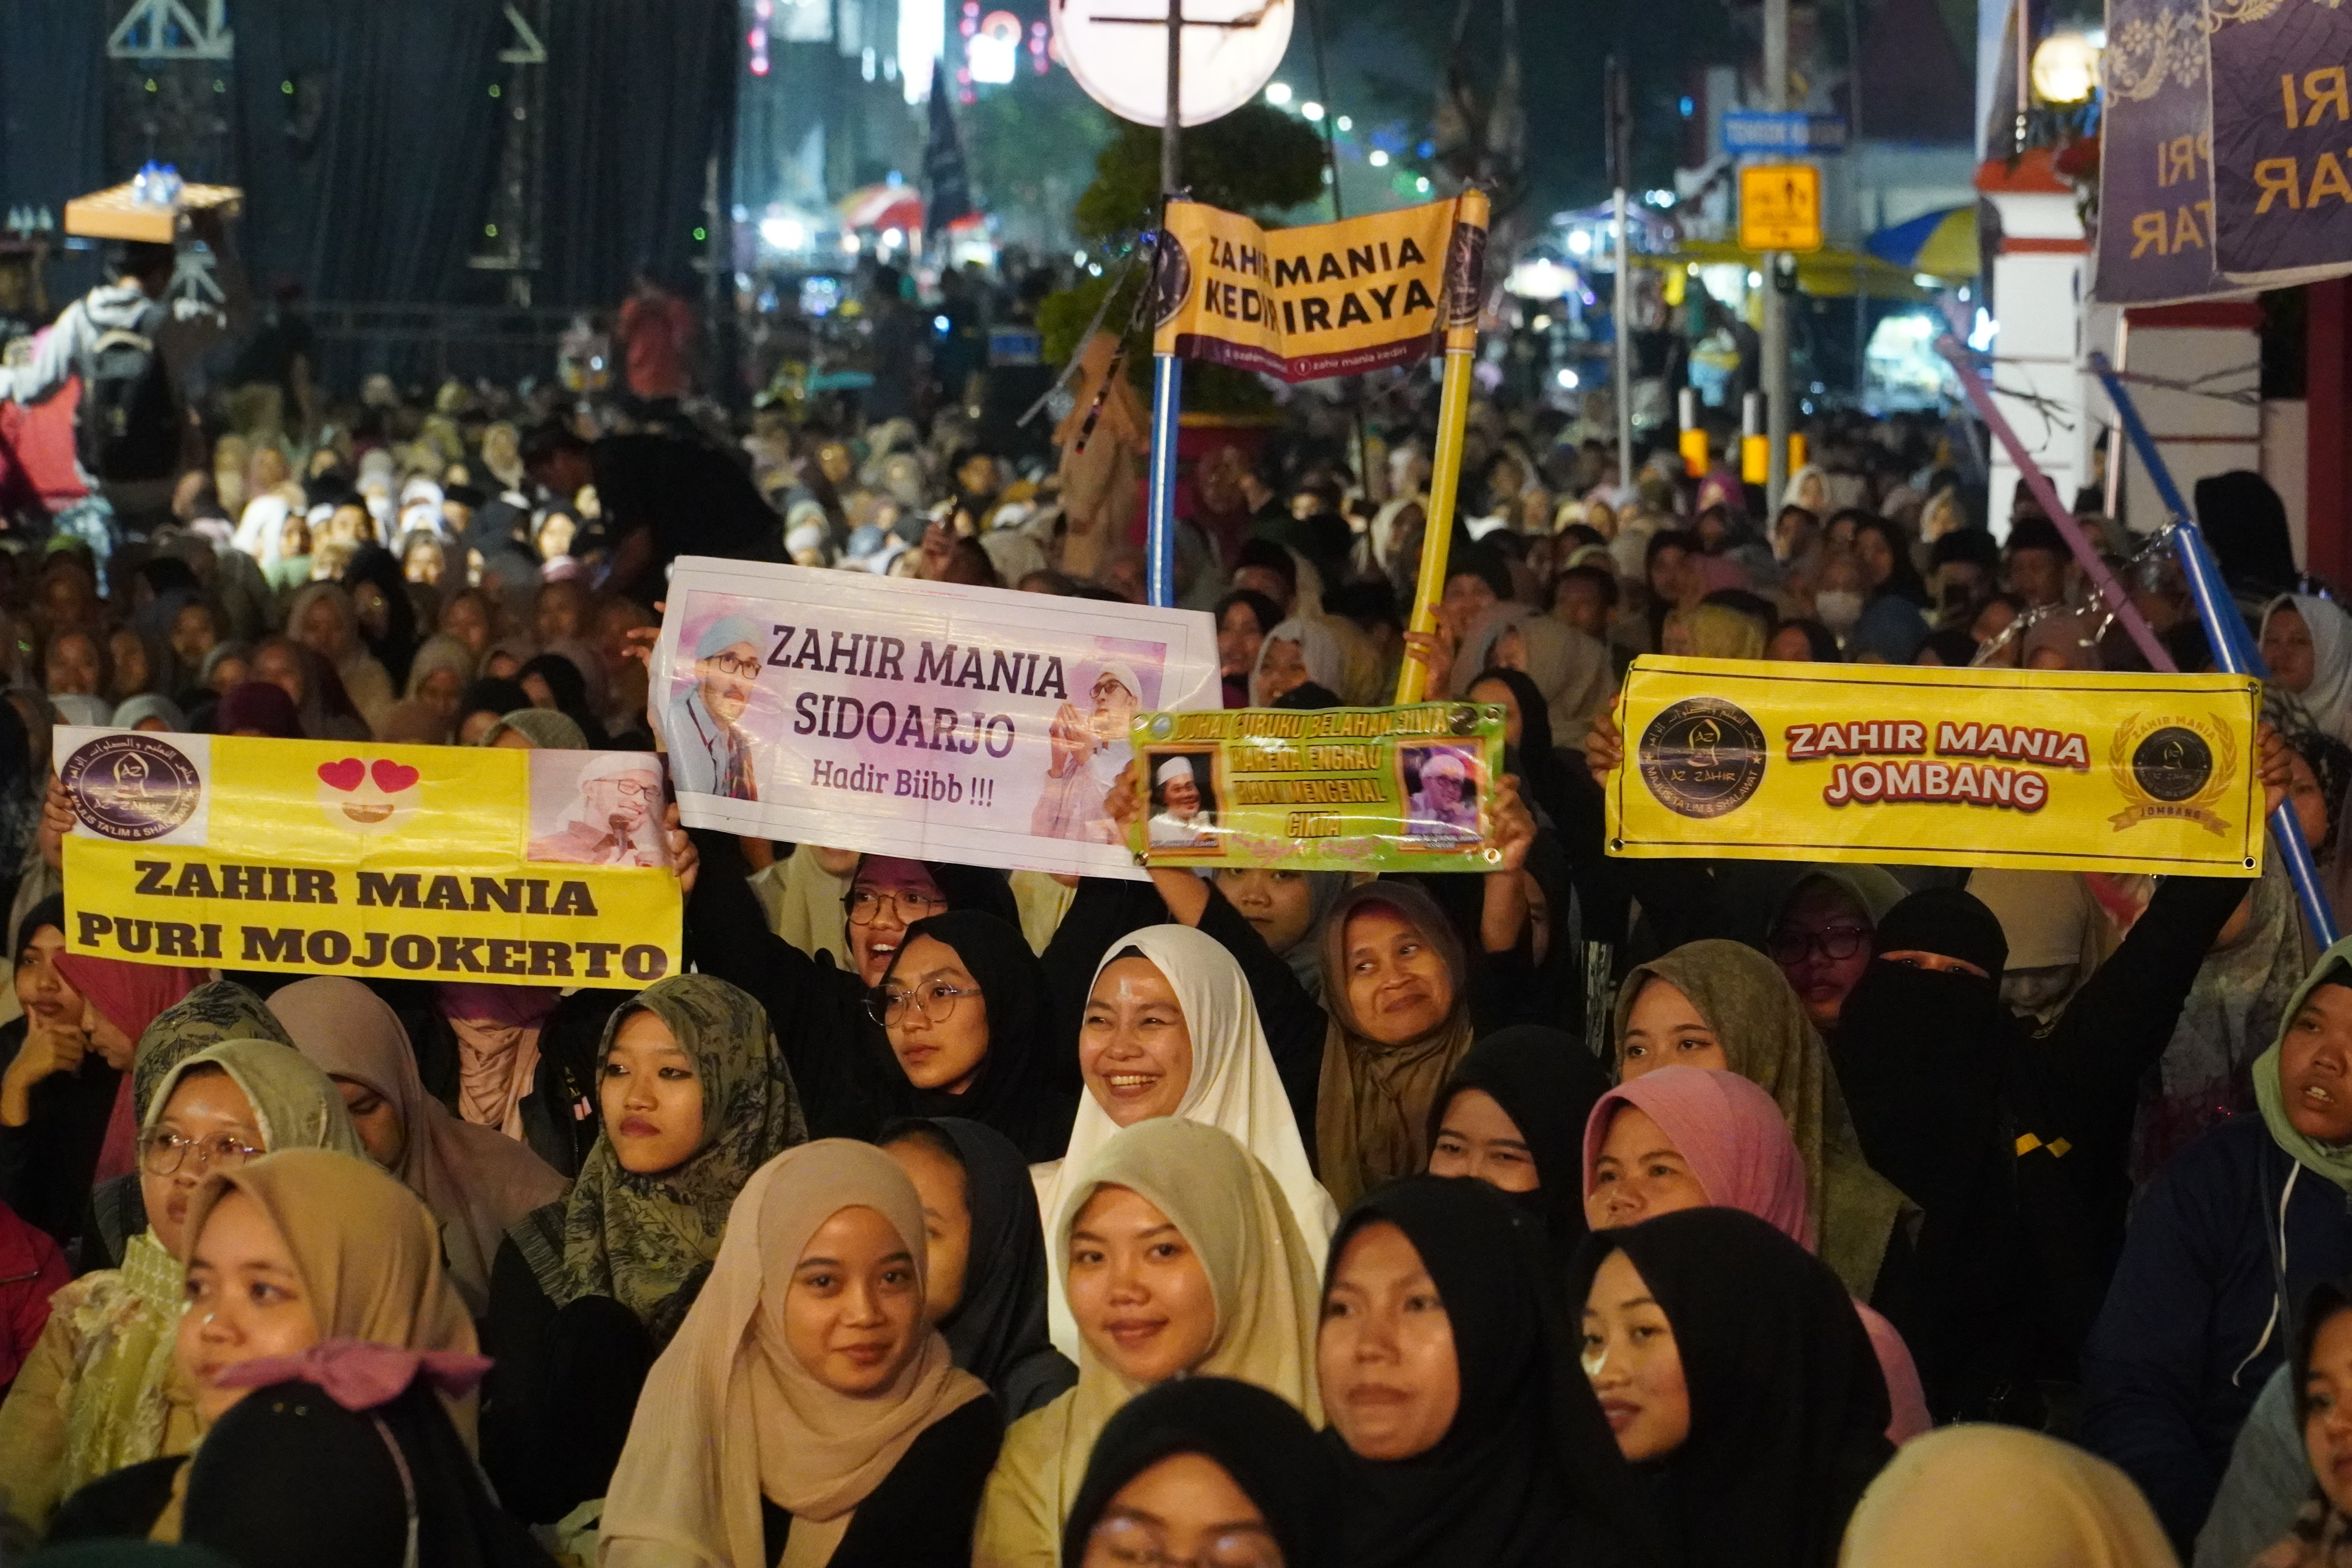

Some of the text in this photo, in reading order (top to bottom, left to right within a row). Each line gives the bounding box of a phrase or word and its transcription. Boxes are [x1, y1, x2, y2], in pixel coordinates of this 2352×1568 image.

[1275, 237, 1425, 289] MANIA
[767, 625, 1068, 700] ZAHIR MANIA
[793, 692, 1015, 758] SIDOARJO
[1235, 713, 1305, 739] GURUKU
[1788, 722, 2089, 767] ZAHIR MANIA
[1306, 744, 1383, 771] ENGKAU
[811, 759, 994, 807] Hadir Biibb !!!
[1825, 762, 2047, 808] JOMBANG
[135, 860, 598, 916] ZAHIR MANIA
[77, 911, 668, 981] PURI MOJOKERTO
